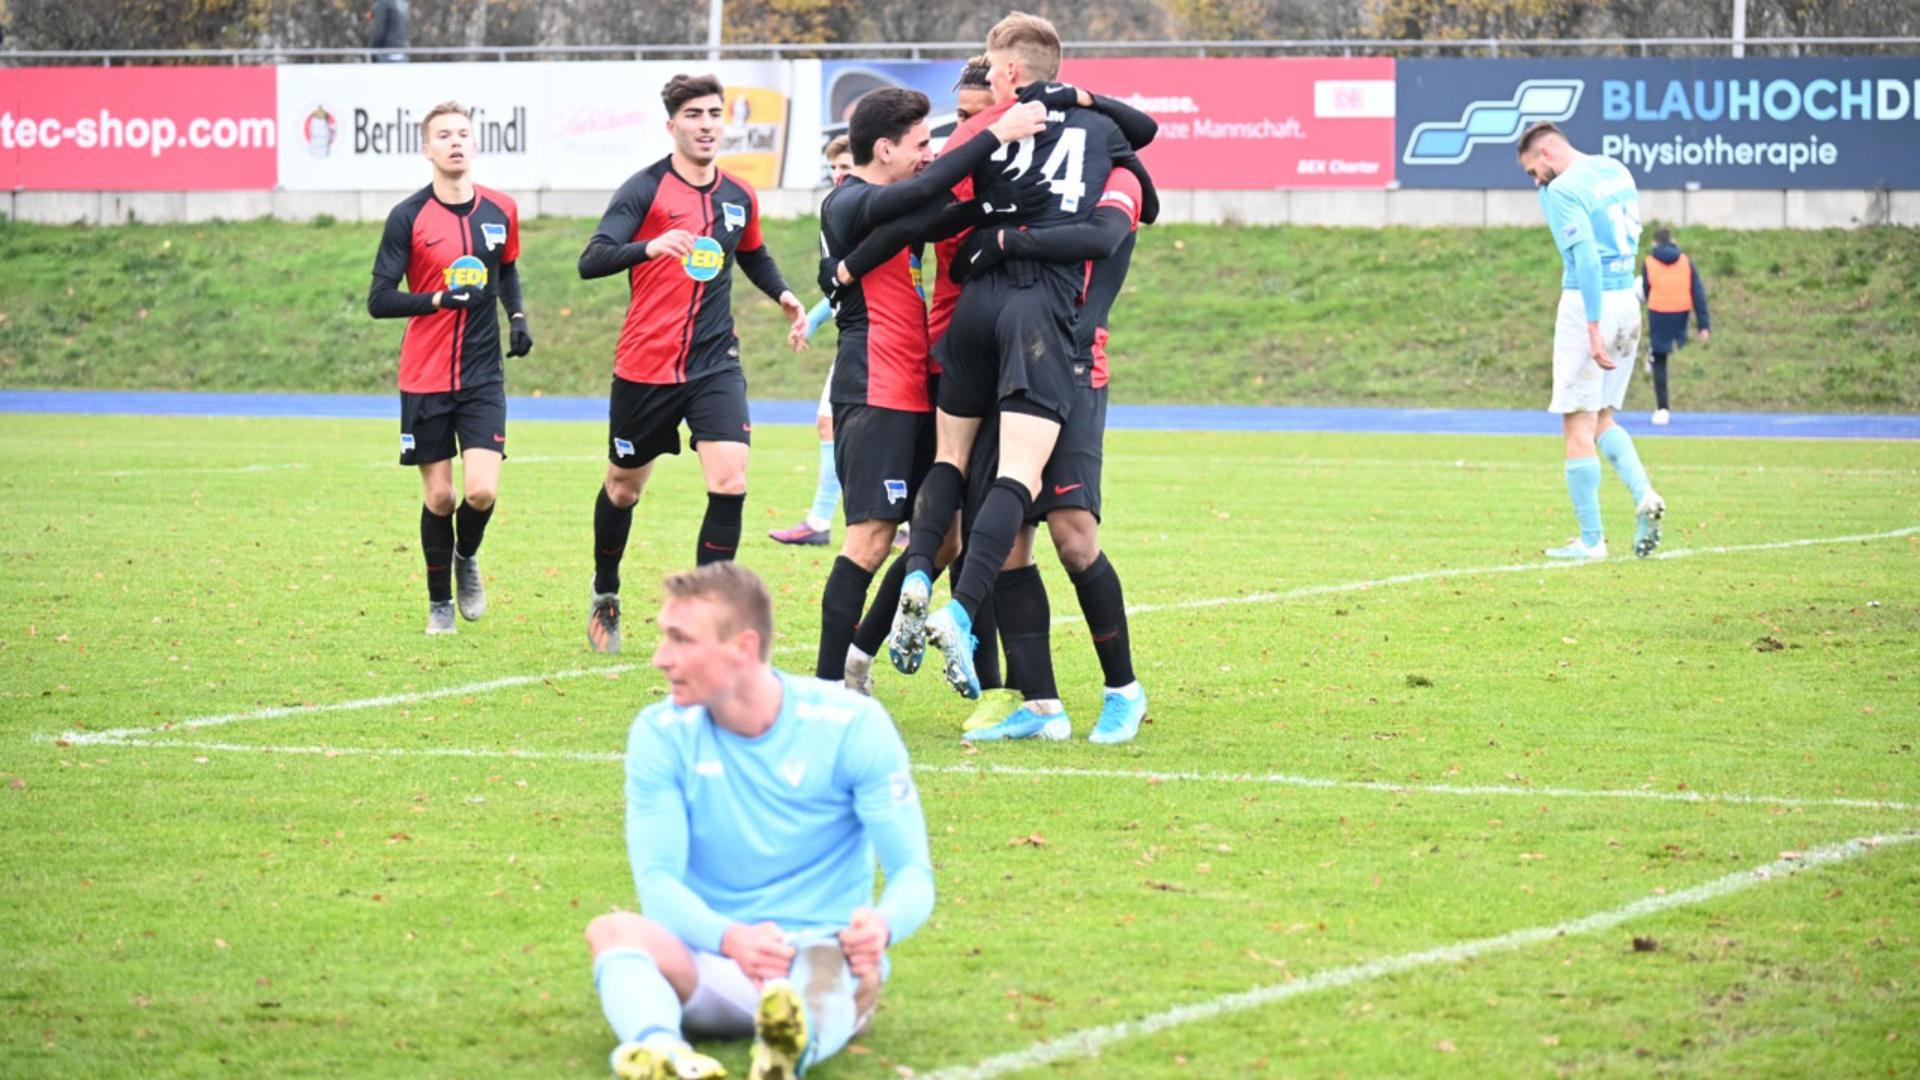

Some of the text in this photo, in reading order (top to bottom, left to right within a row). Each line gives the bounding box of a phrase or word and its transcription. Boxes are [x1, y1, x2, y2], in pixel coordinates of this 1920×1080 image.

[0, 109, 275, 157] tec-shop.com
[354, 107, 422, 154] Berlin
[469, 106, 526, 154] indl
[1193, 117, 1307, 138] Mannschaft.
[1602, 133, 1838, 173] Physiotherapie
